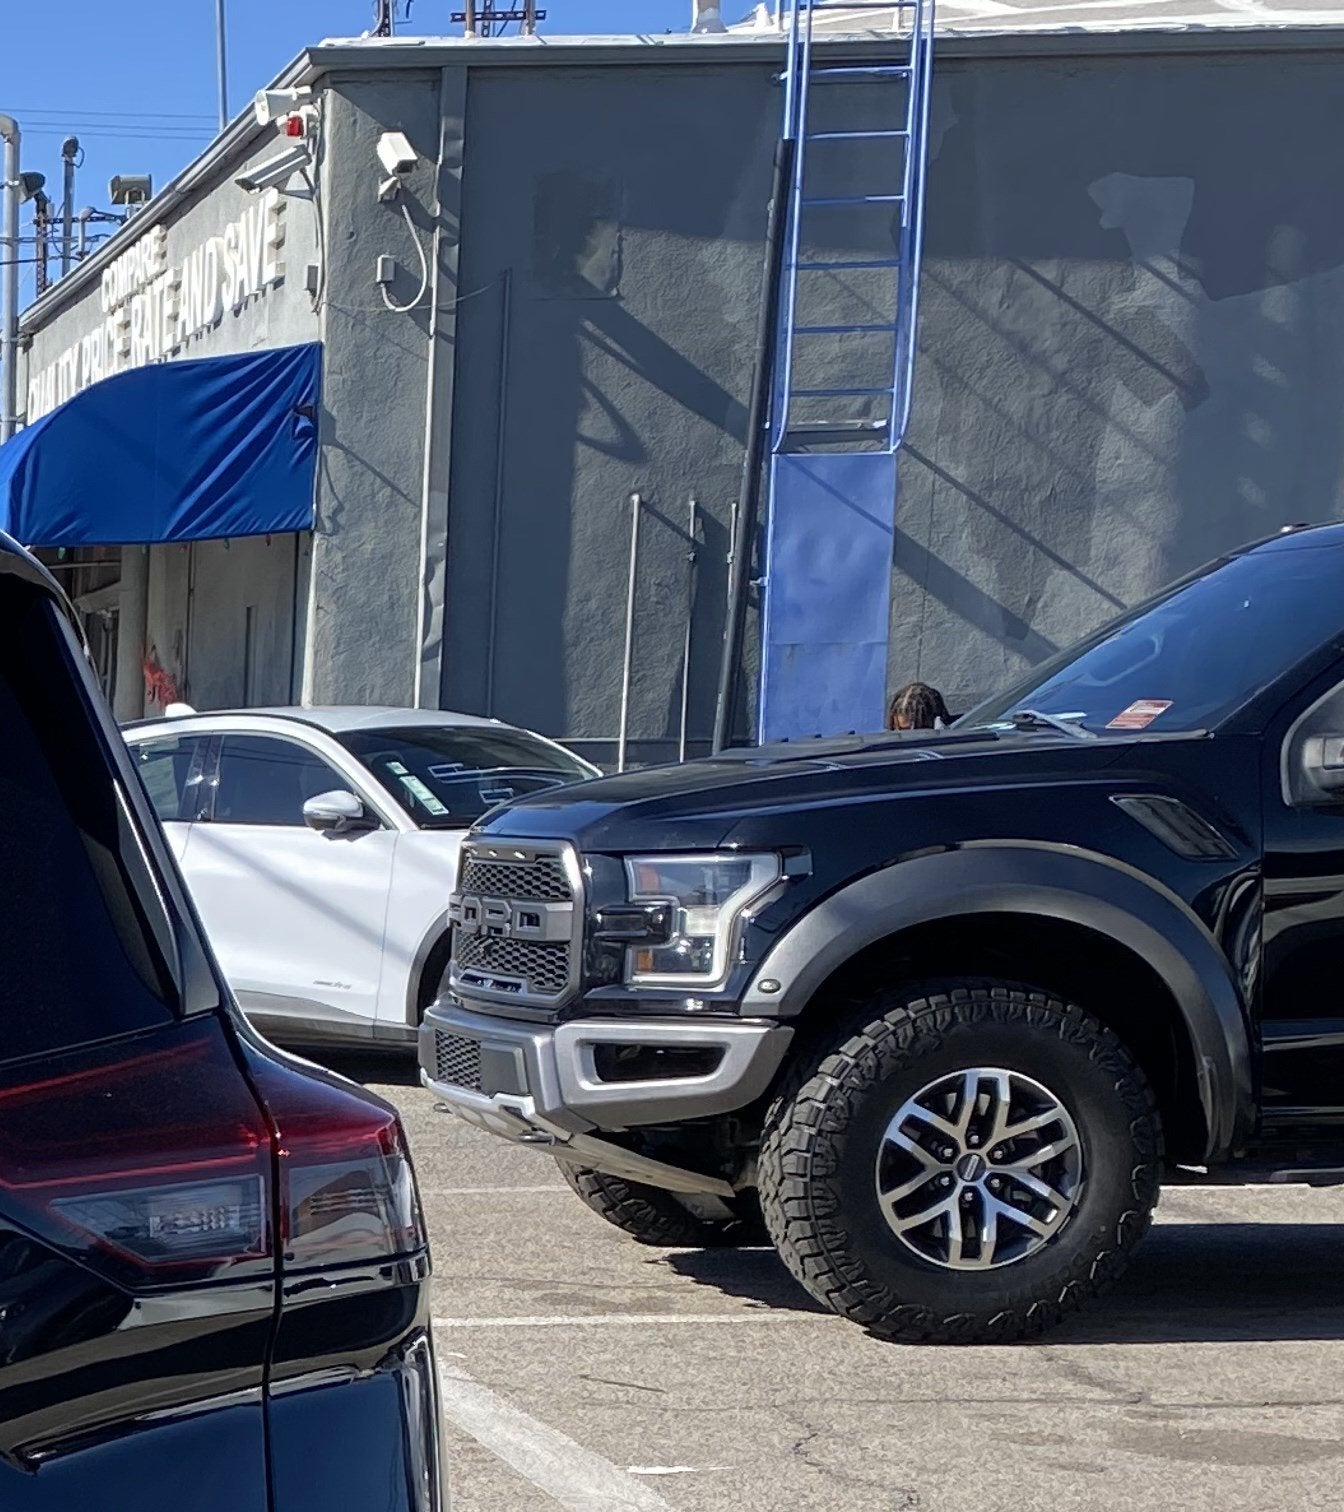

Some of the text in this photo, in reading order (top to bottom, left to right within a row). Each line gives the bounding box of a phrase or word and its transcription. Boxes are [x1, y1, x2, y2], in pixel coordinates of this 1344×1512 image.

[102, 225, 166, 312] COMPARE
[131, 268, 180, 366] RATE
[178, 237, 225, 345] AND
[221, 186, 285, 313] SAVE
